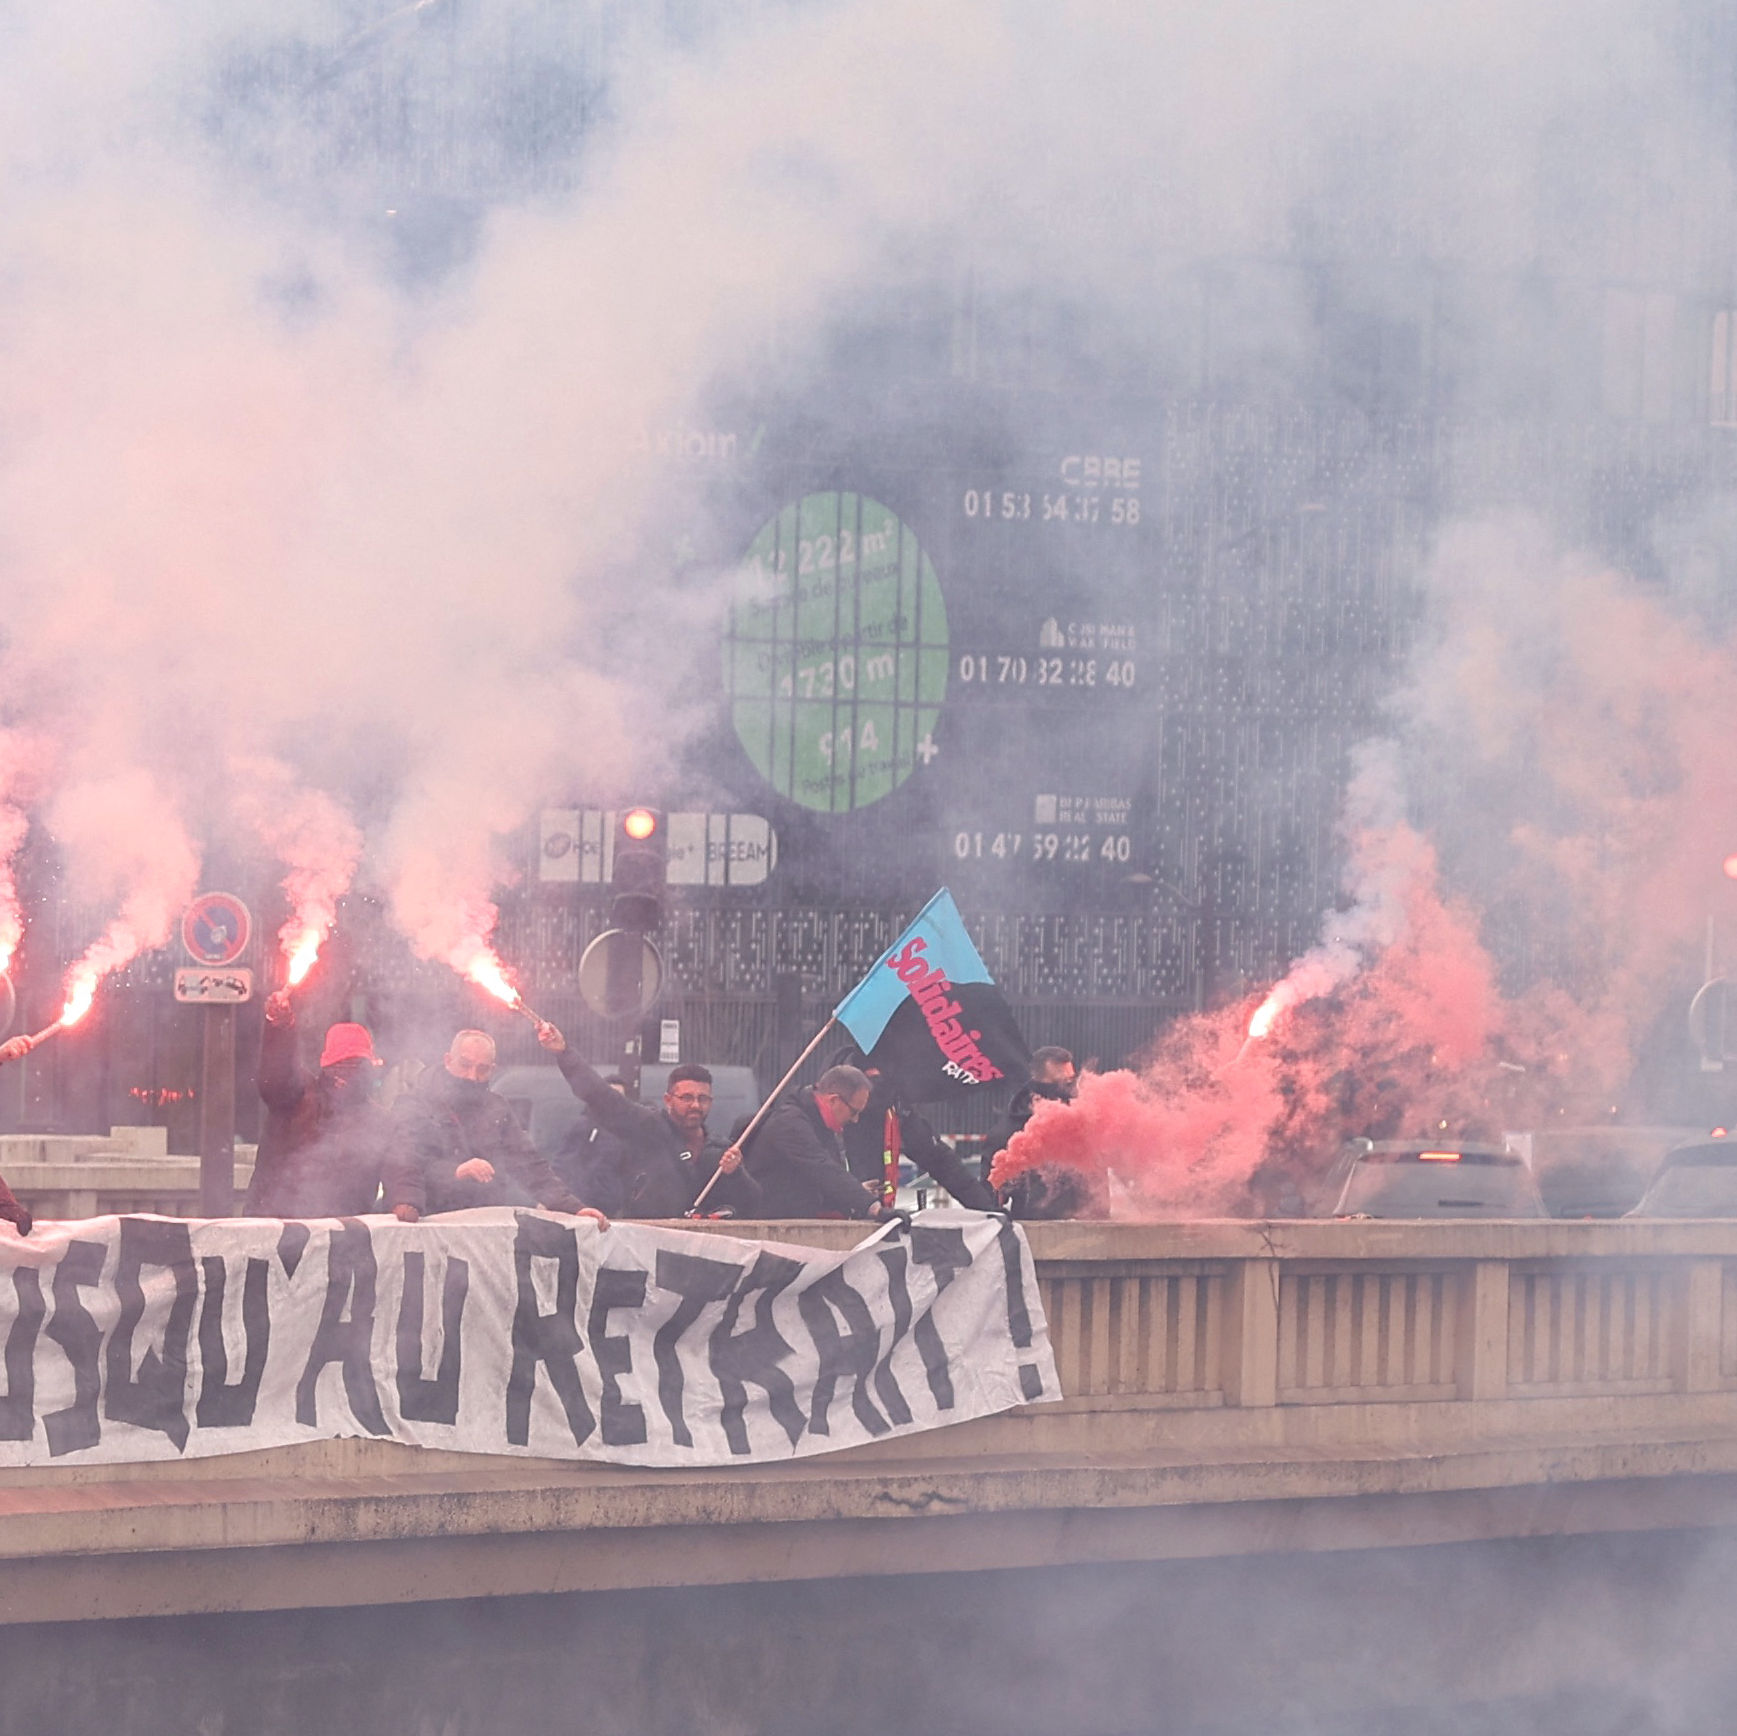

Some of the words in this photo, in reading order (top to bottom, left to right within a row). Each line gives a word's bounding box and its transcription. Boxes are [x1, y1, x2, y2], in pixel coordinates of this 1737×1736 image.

[1111, 498, 1140, 526] 58
[1106, 660, 1135, 687] 40
[708, 842, 769, 862] BREEAM
[1101, 835, 1130, 862] 40
[942, 1060, 980, 1085] RATP
